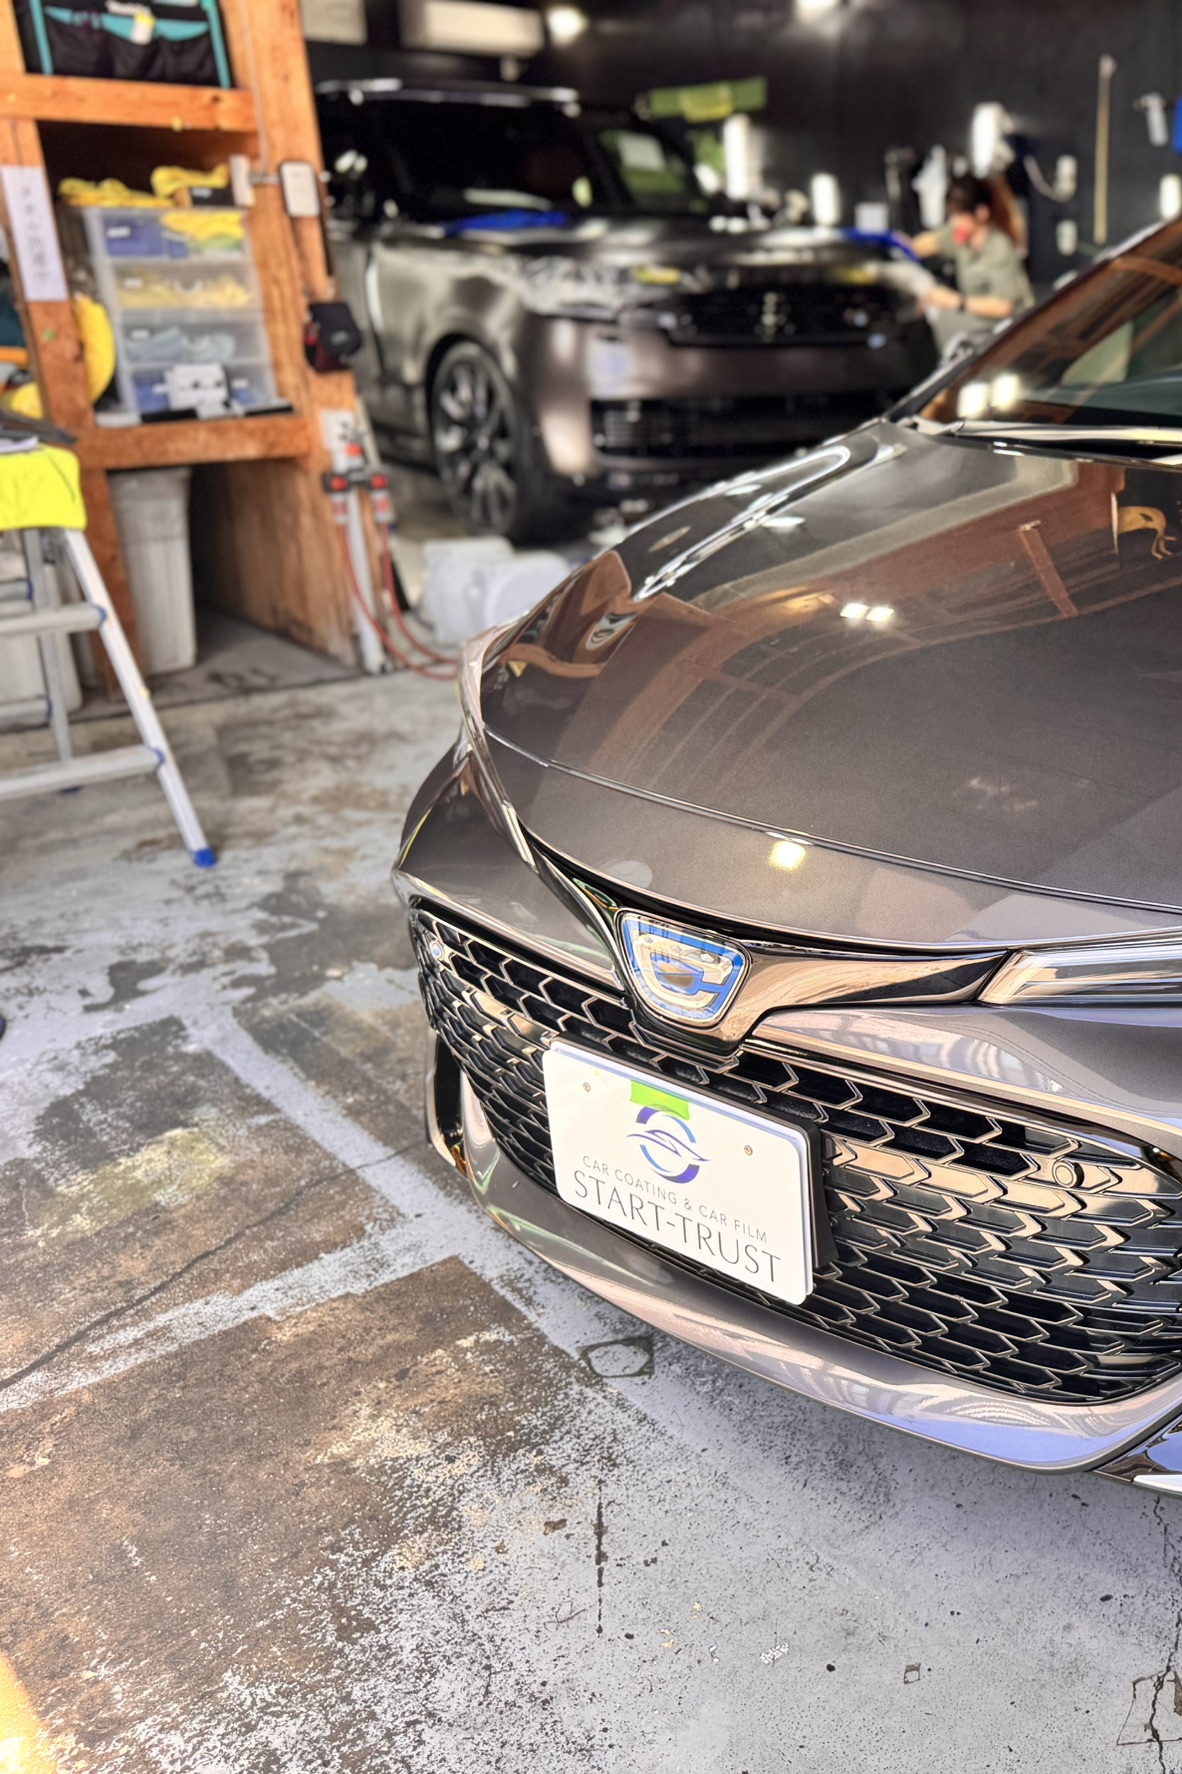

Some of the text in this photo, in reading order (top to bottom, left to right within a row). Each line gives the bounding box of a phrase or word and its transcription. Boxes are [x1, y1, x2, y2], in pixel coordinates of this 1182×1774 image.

[573, 1170, 781, 1283] START-TRUST
[582, 1155, 768, 1244] CAR COATING & CAR FILM
